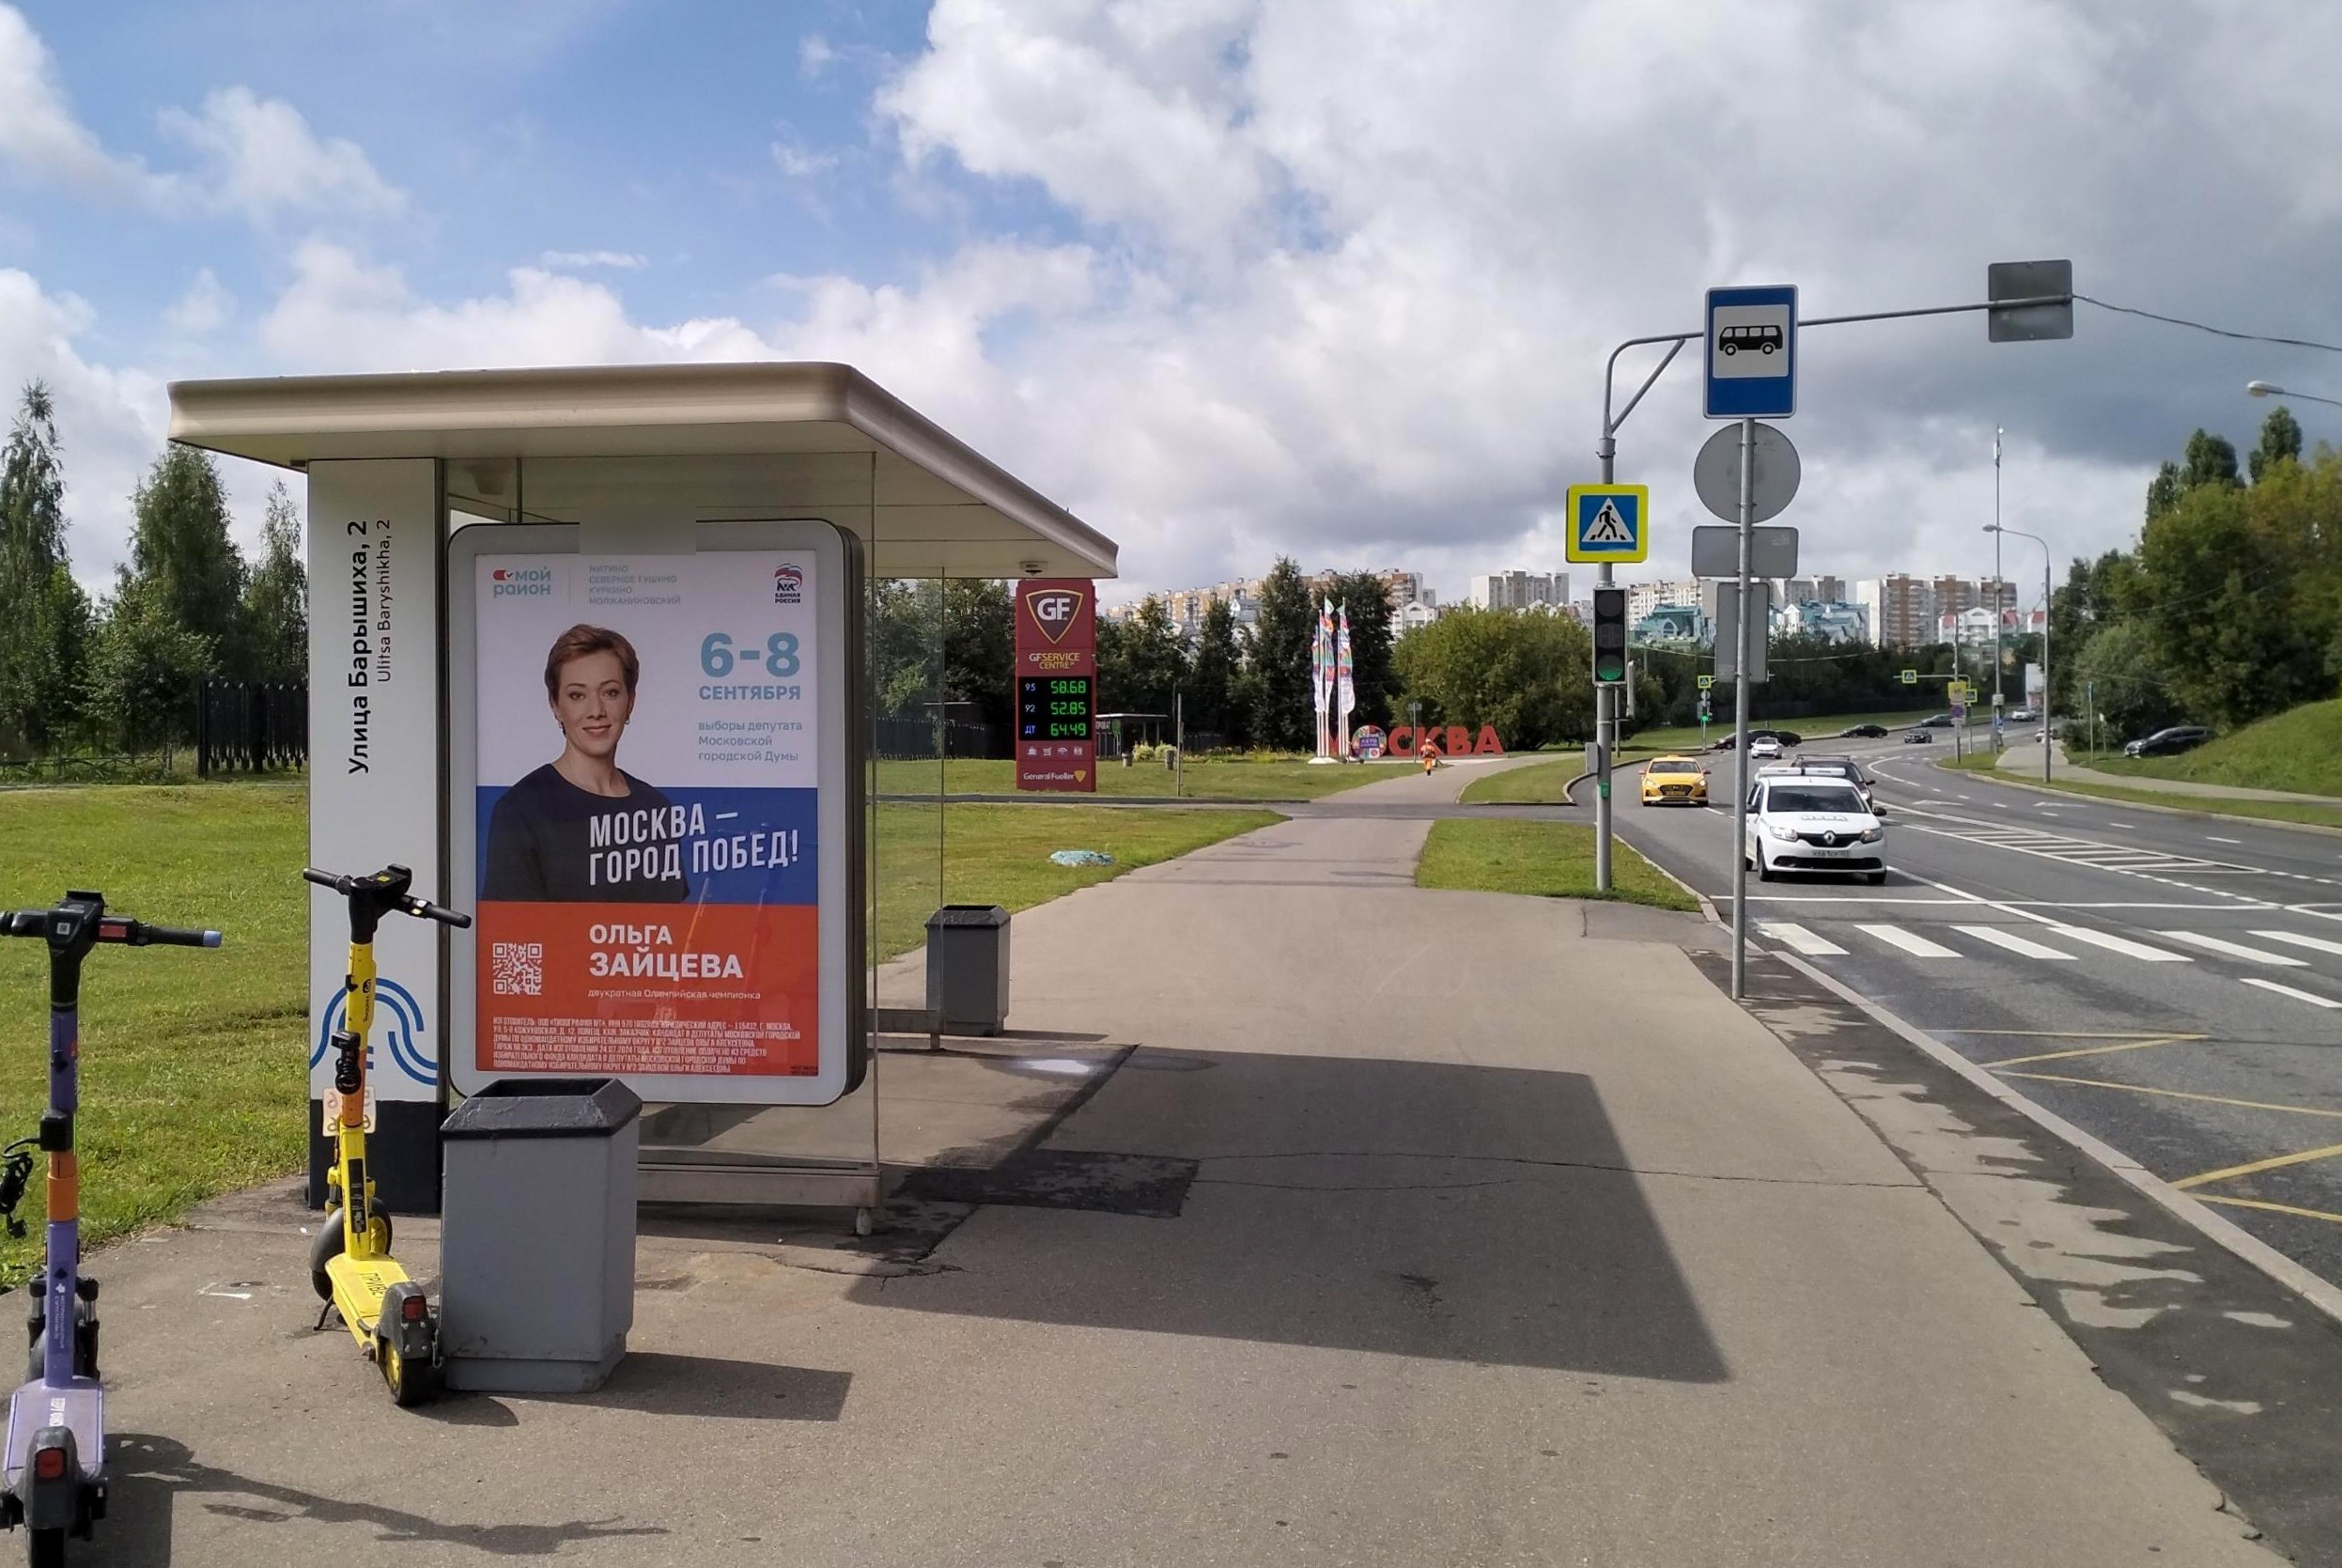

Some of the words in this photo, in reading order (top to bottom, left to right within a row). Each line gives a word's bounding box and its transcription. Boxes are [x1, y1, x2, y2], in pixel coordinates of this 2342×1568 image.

[348, 520, 367, 536] 2
[377, 520, 390, 530] 2
[376, 536, 393, 630] Baryshikha,
[349, 543, 372, 688] Барышиха,
[1037, 598, 1071, 621] GF
[377, 636, 391, 682] Ulitsa
[699, 685, 801, 701] СЕНТЯБРЯ
[1024, 683, 1036, 691] 95
[1050, 680, 1087, 694] 58.68
[1024, 704, 1036, 712] 92
[1050, 702, 1087, 716] 52.85
[699, 720, 746, 732] выборы
[747, 722, 802, 732] депутата
[1024, 725, 1036, 735] ДТ
[1050, 722, 1087, 737] 64.49
[349, 695, 371, 774] Улица
[699, 736, 772, 746] Московской
[699, 751, 762, 762] городской
[765, 752, 799, 763] Думы
[590, 803, 706, 848] МОСКВА
[590, 843, 681, 886] ГОРОД
[692, 829, 799, 874] ПОБЕД!
[589, 924, 673, 945] ОЛЬГА
[589, 946, 744, 982] ЗАЙЦЕВА
[588, 989, 642, 999] двукратная
